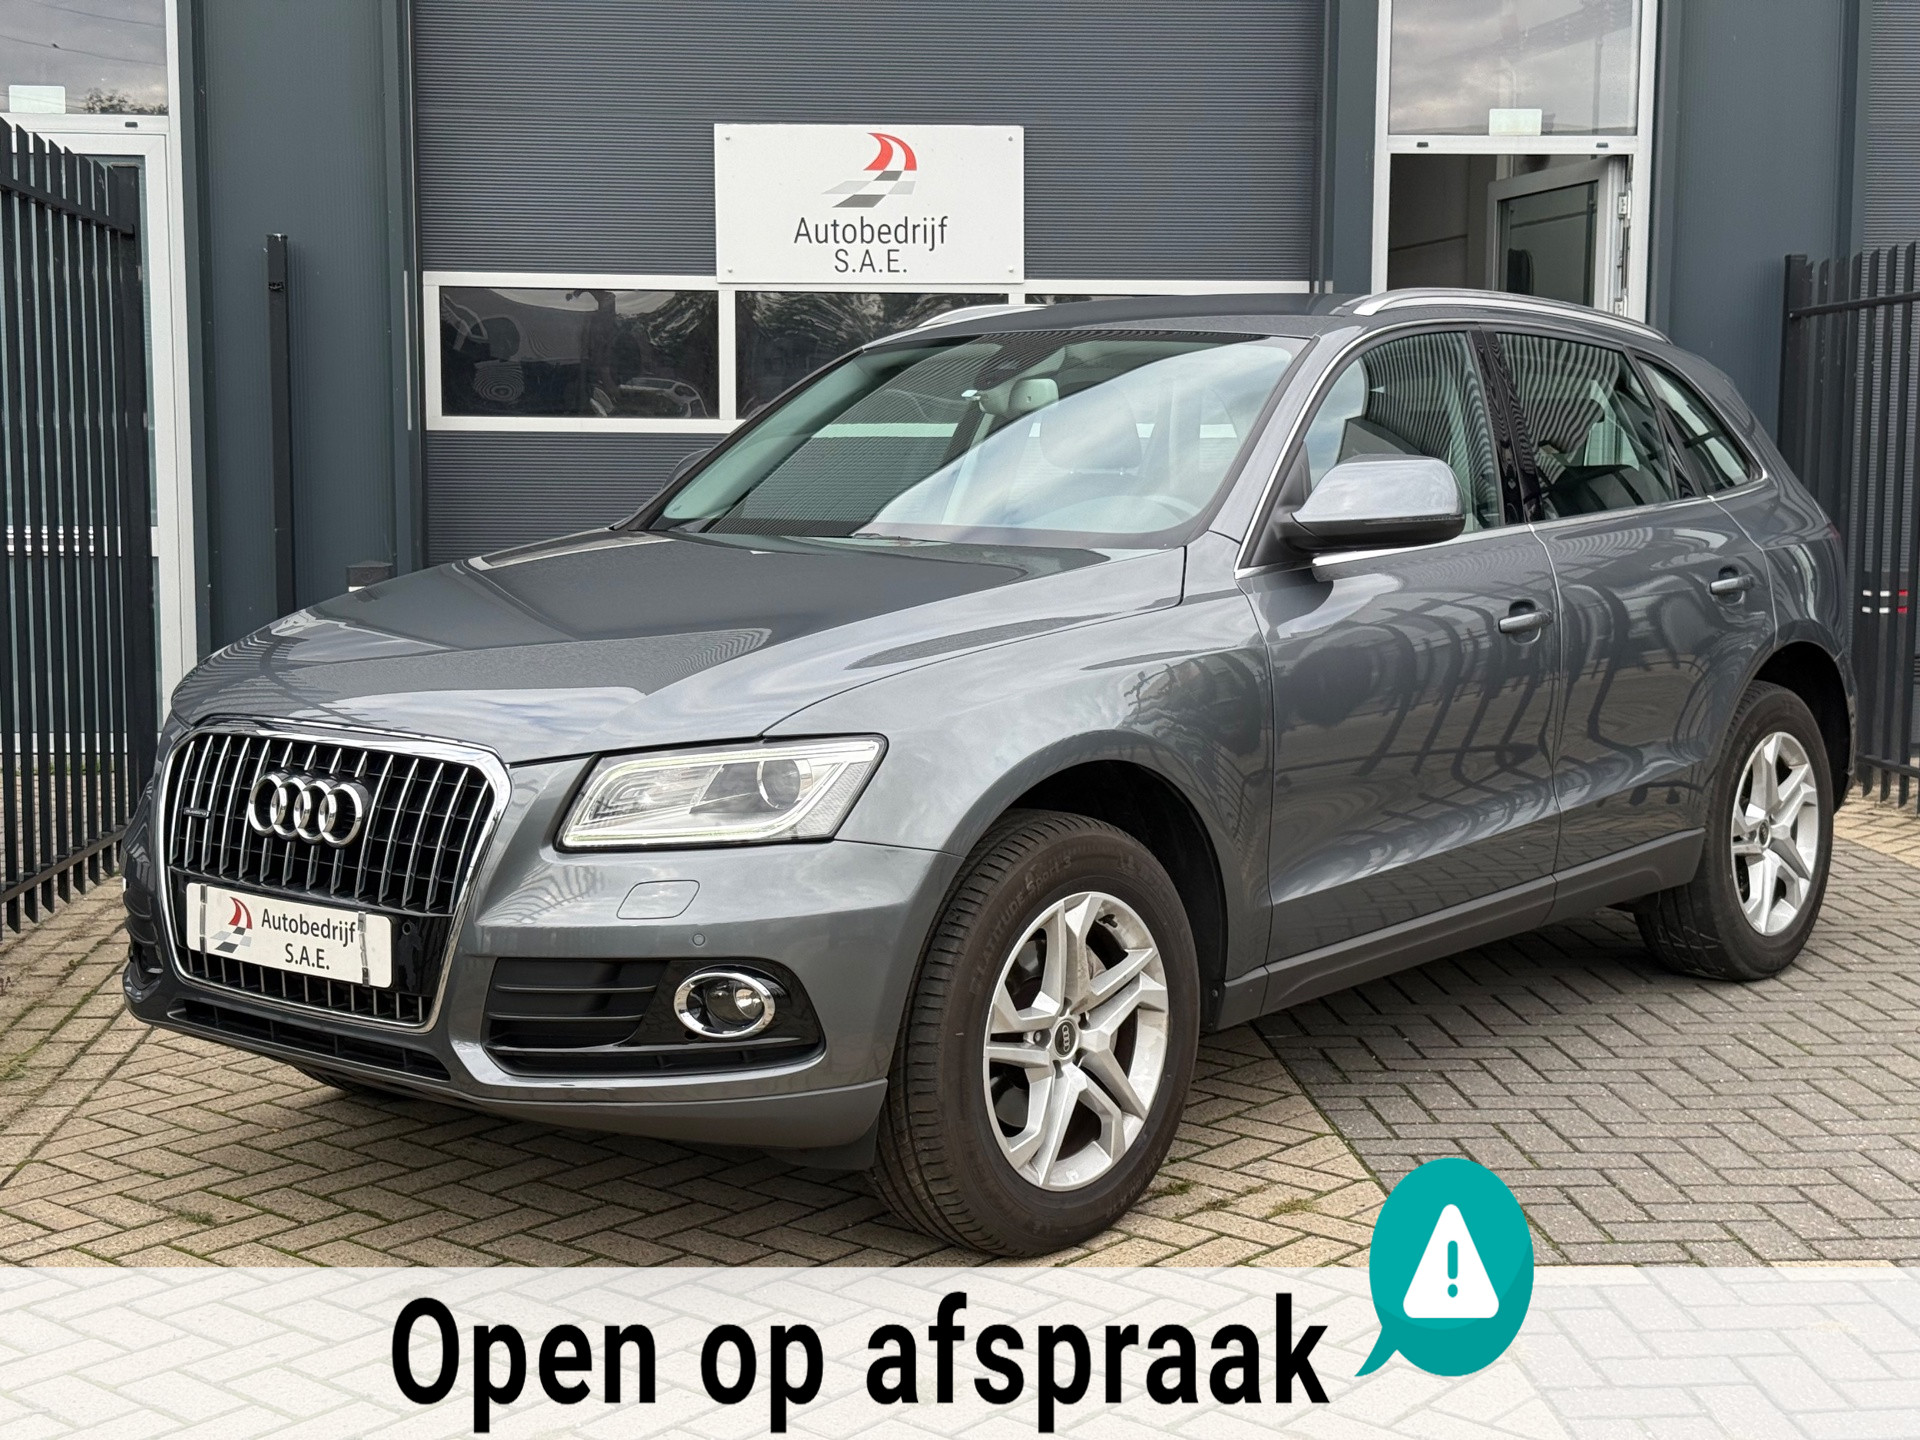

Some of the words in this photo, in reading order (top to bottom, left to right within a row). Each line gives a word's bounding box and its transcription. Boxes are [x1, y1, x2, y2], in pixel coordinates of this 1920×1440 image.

[794, 215, 948, 252] Autobedrijf
[834, 248, 907, 273] S.A.E.
[261, 908, 356, 948] Autobedrijf
[285, 942, 330, 971] S.A.E.
